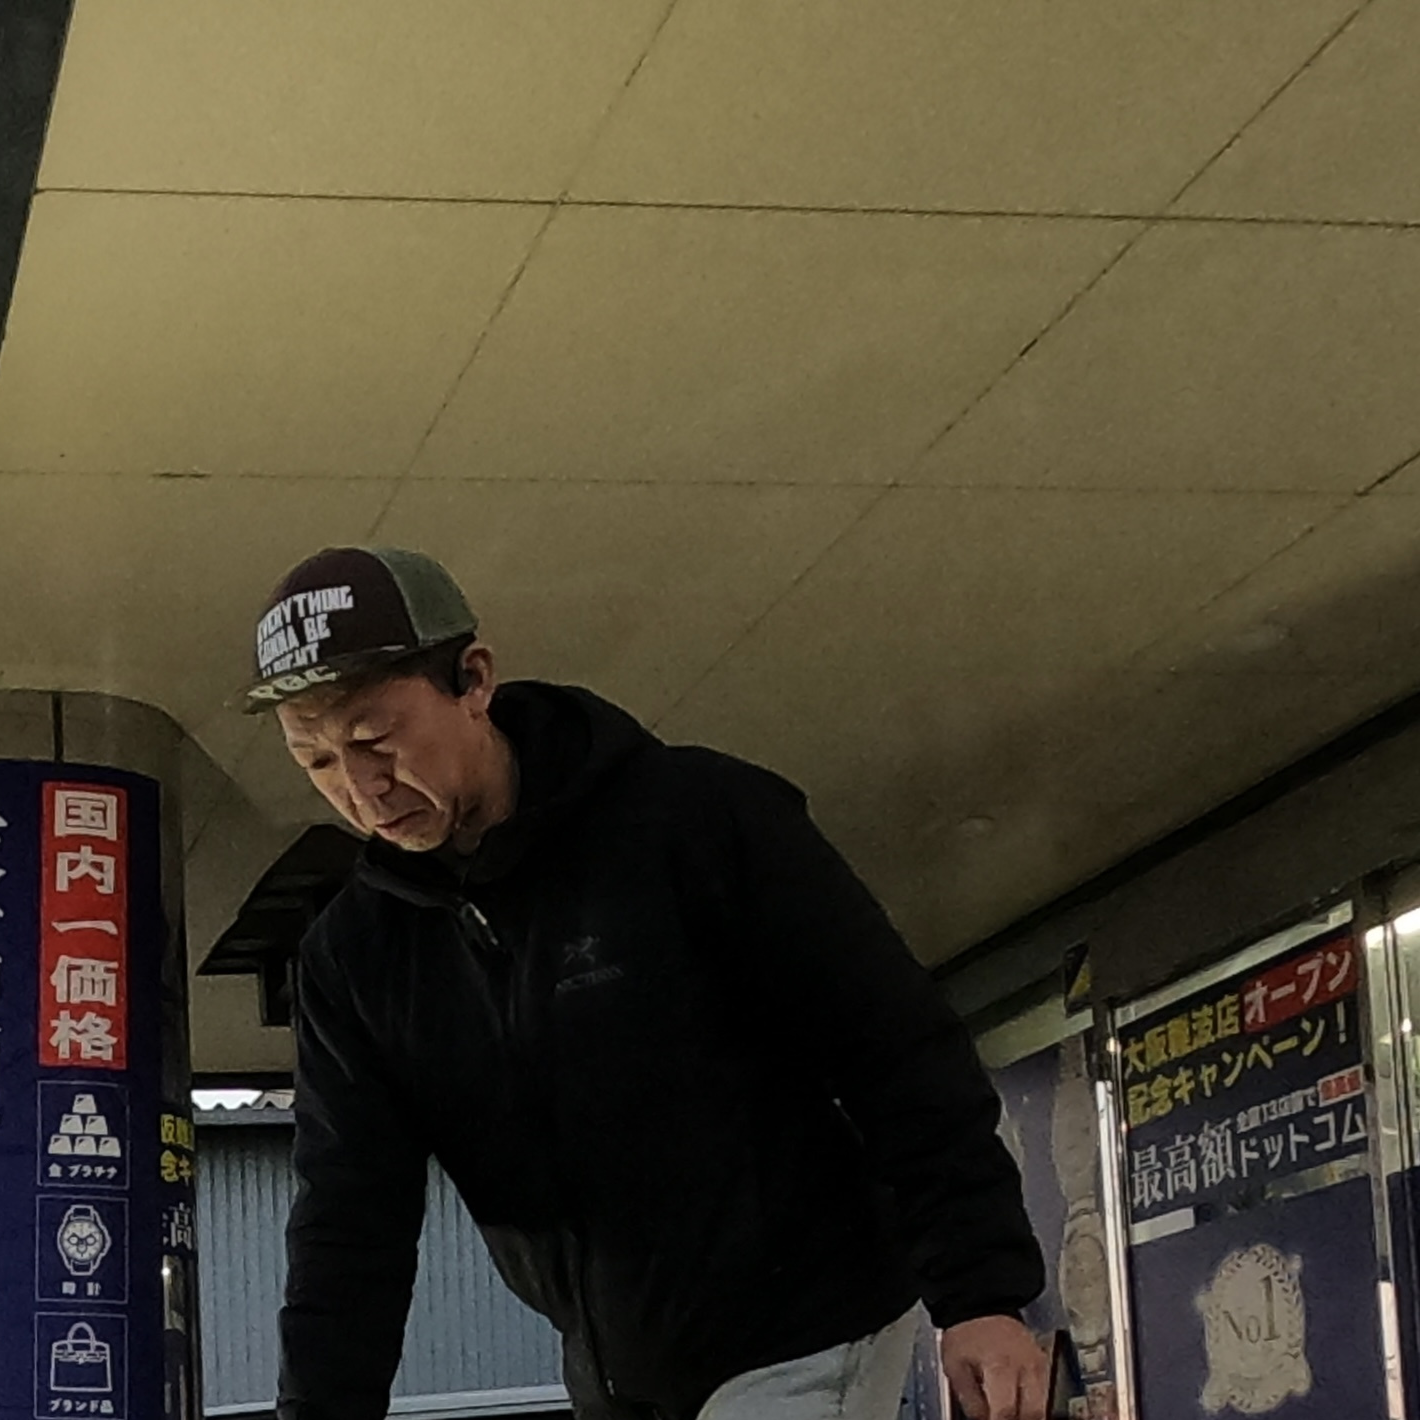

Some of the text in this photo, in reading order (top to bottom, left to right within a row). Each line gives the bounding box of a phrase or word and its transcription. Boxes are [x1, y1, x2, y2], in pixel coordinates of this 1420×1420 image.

[302, 613, 332, 643] BE
[48, 789, 119, 1061] 国内一価格
